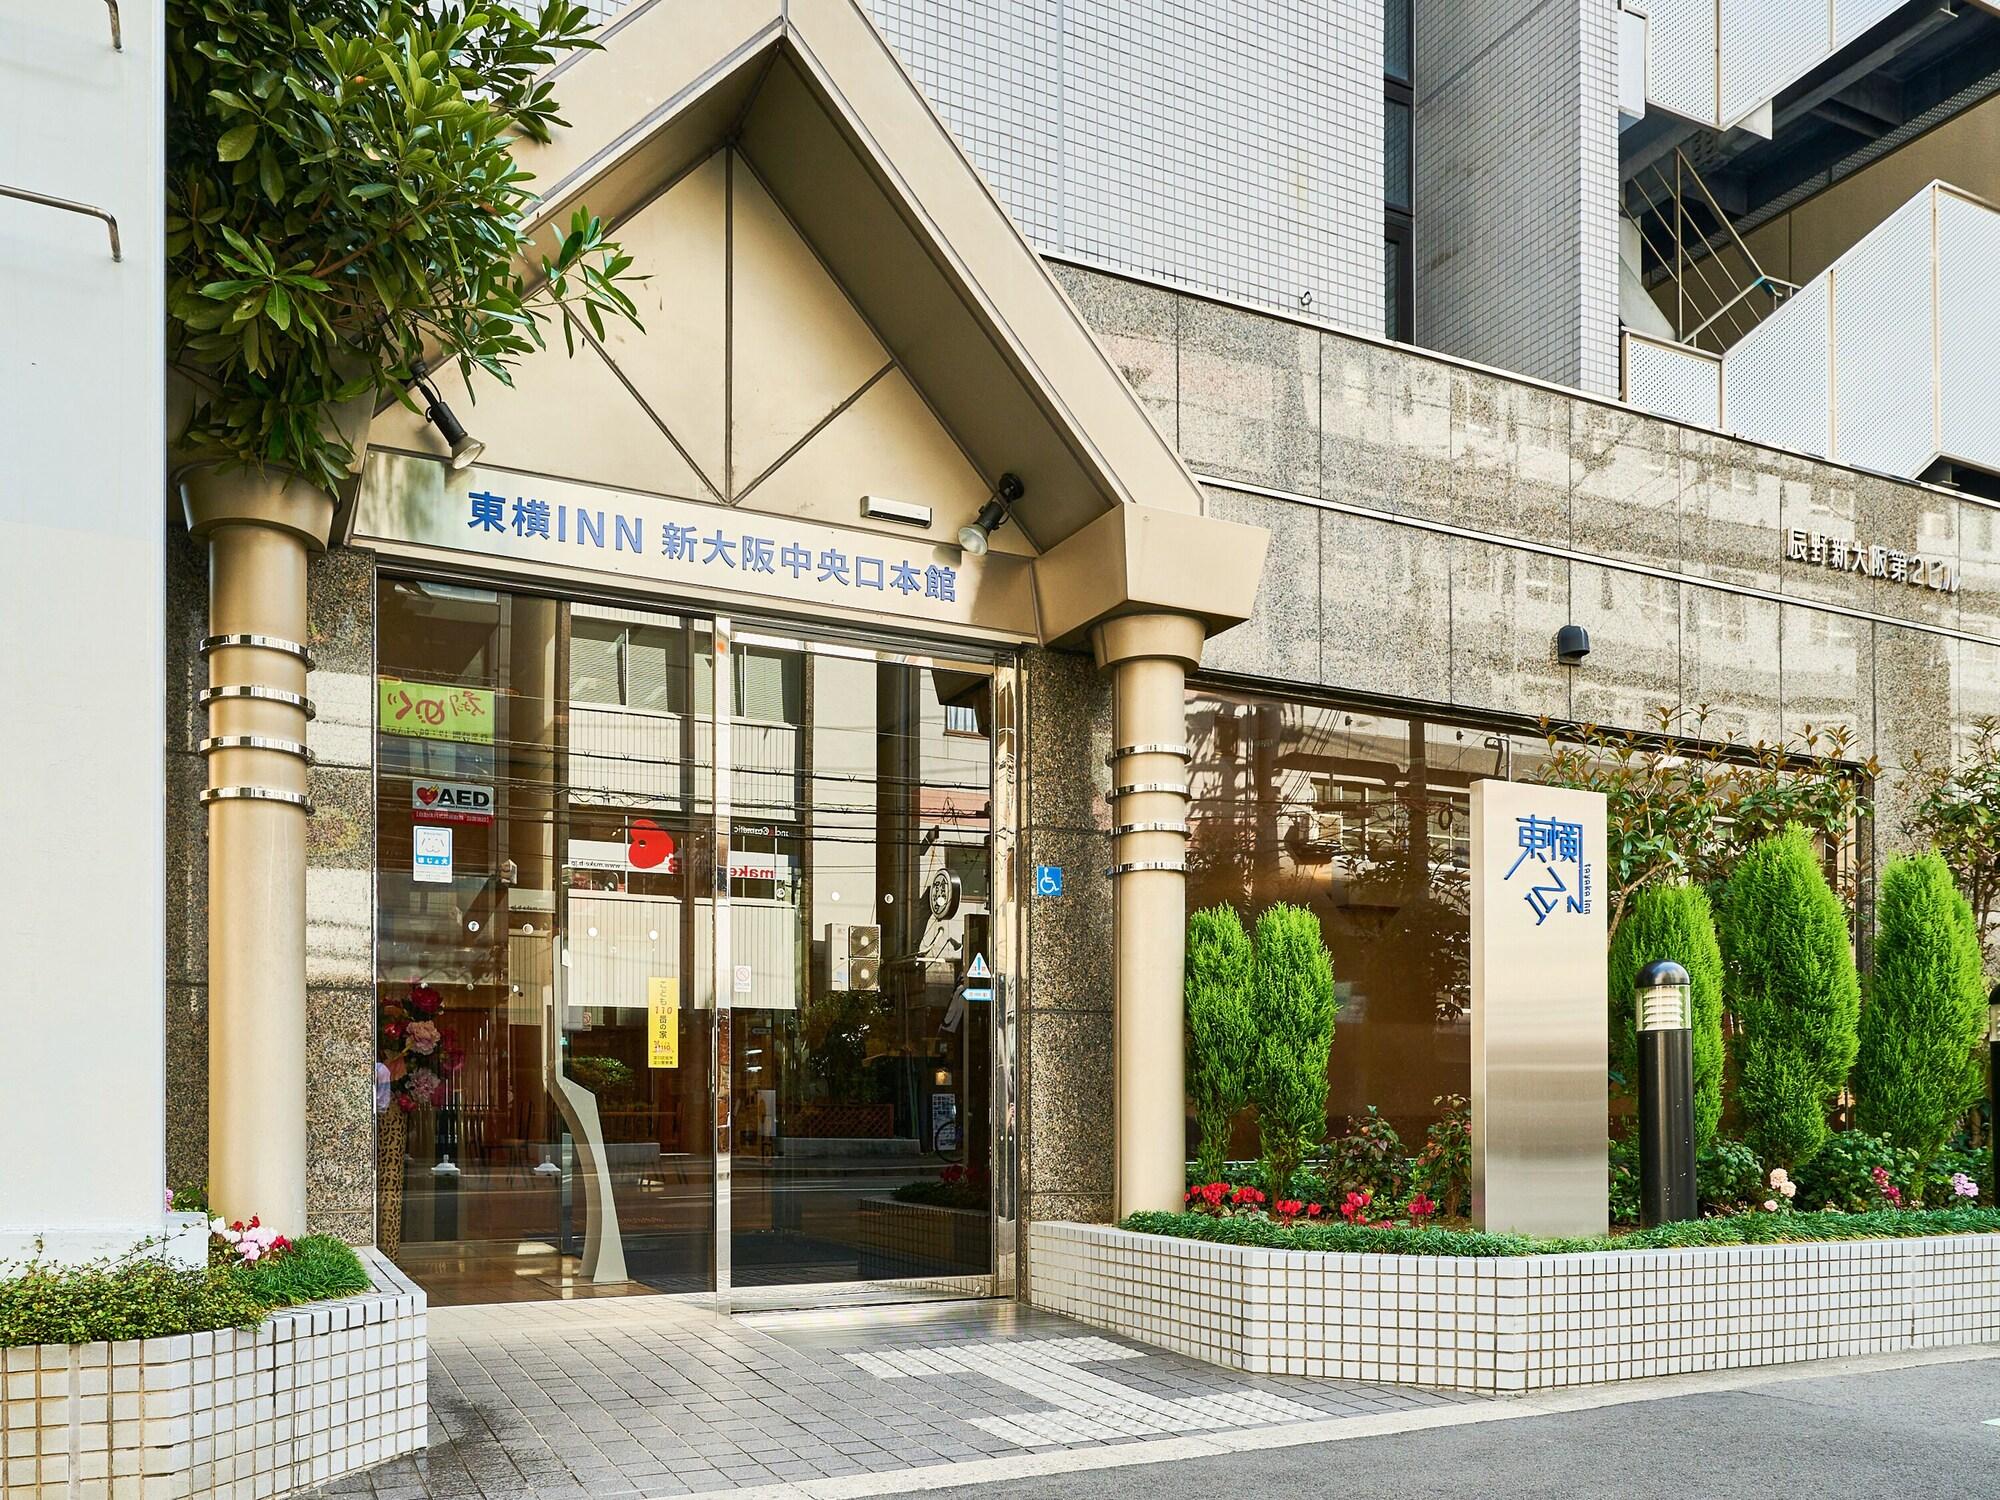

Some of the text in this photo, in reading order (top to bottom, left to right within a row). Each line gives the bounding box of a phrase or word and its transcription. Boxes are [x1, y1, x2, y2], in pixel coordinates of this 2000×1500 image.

[467, 490, 959, 602] 東横INN 新大阪中央口本館
[1786, 526, 1961, 593] 辰野新大阪第2ビル
[437, 788, 490, 807] AED
